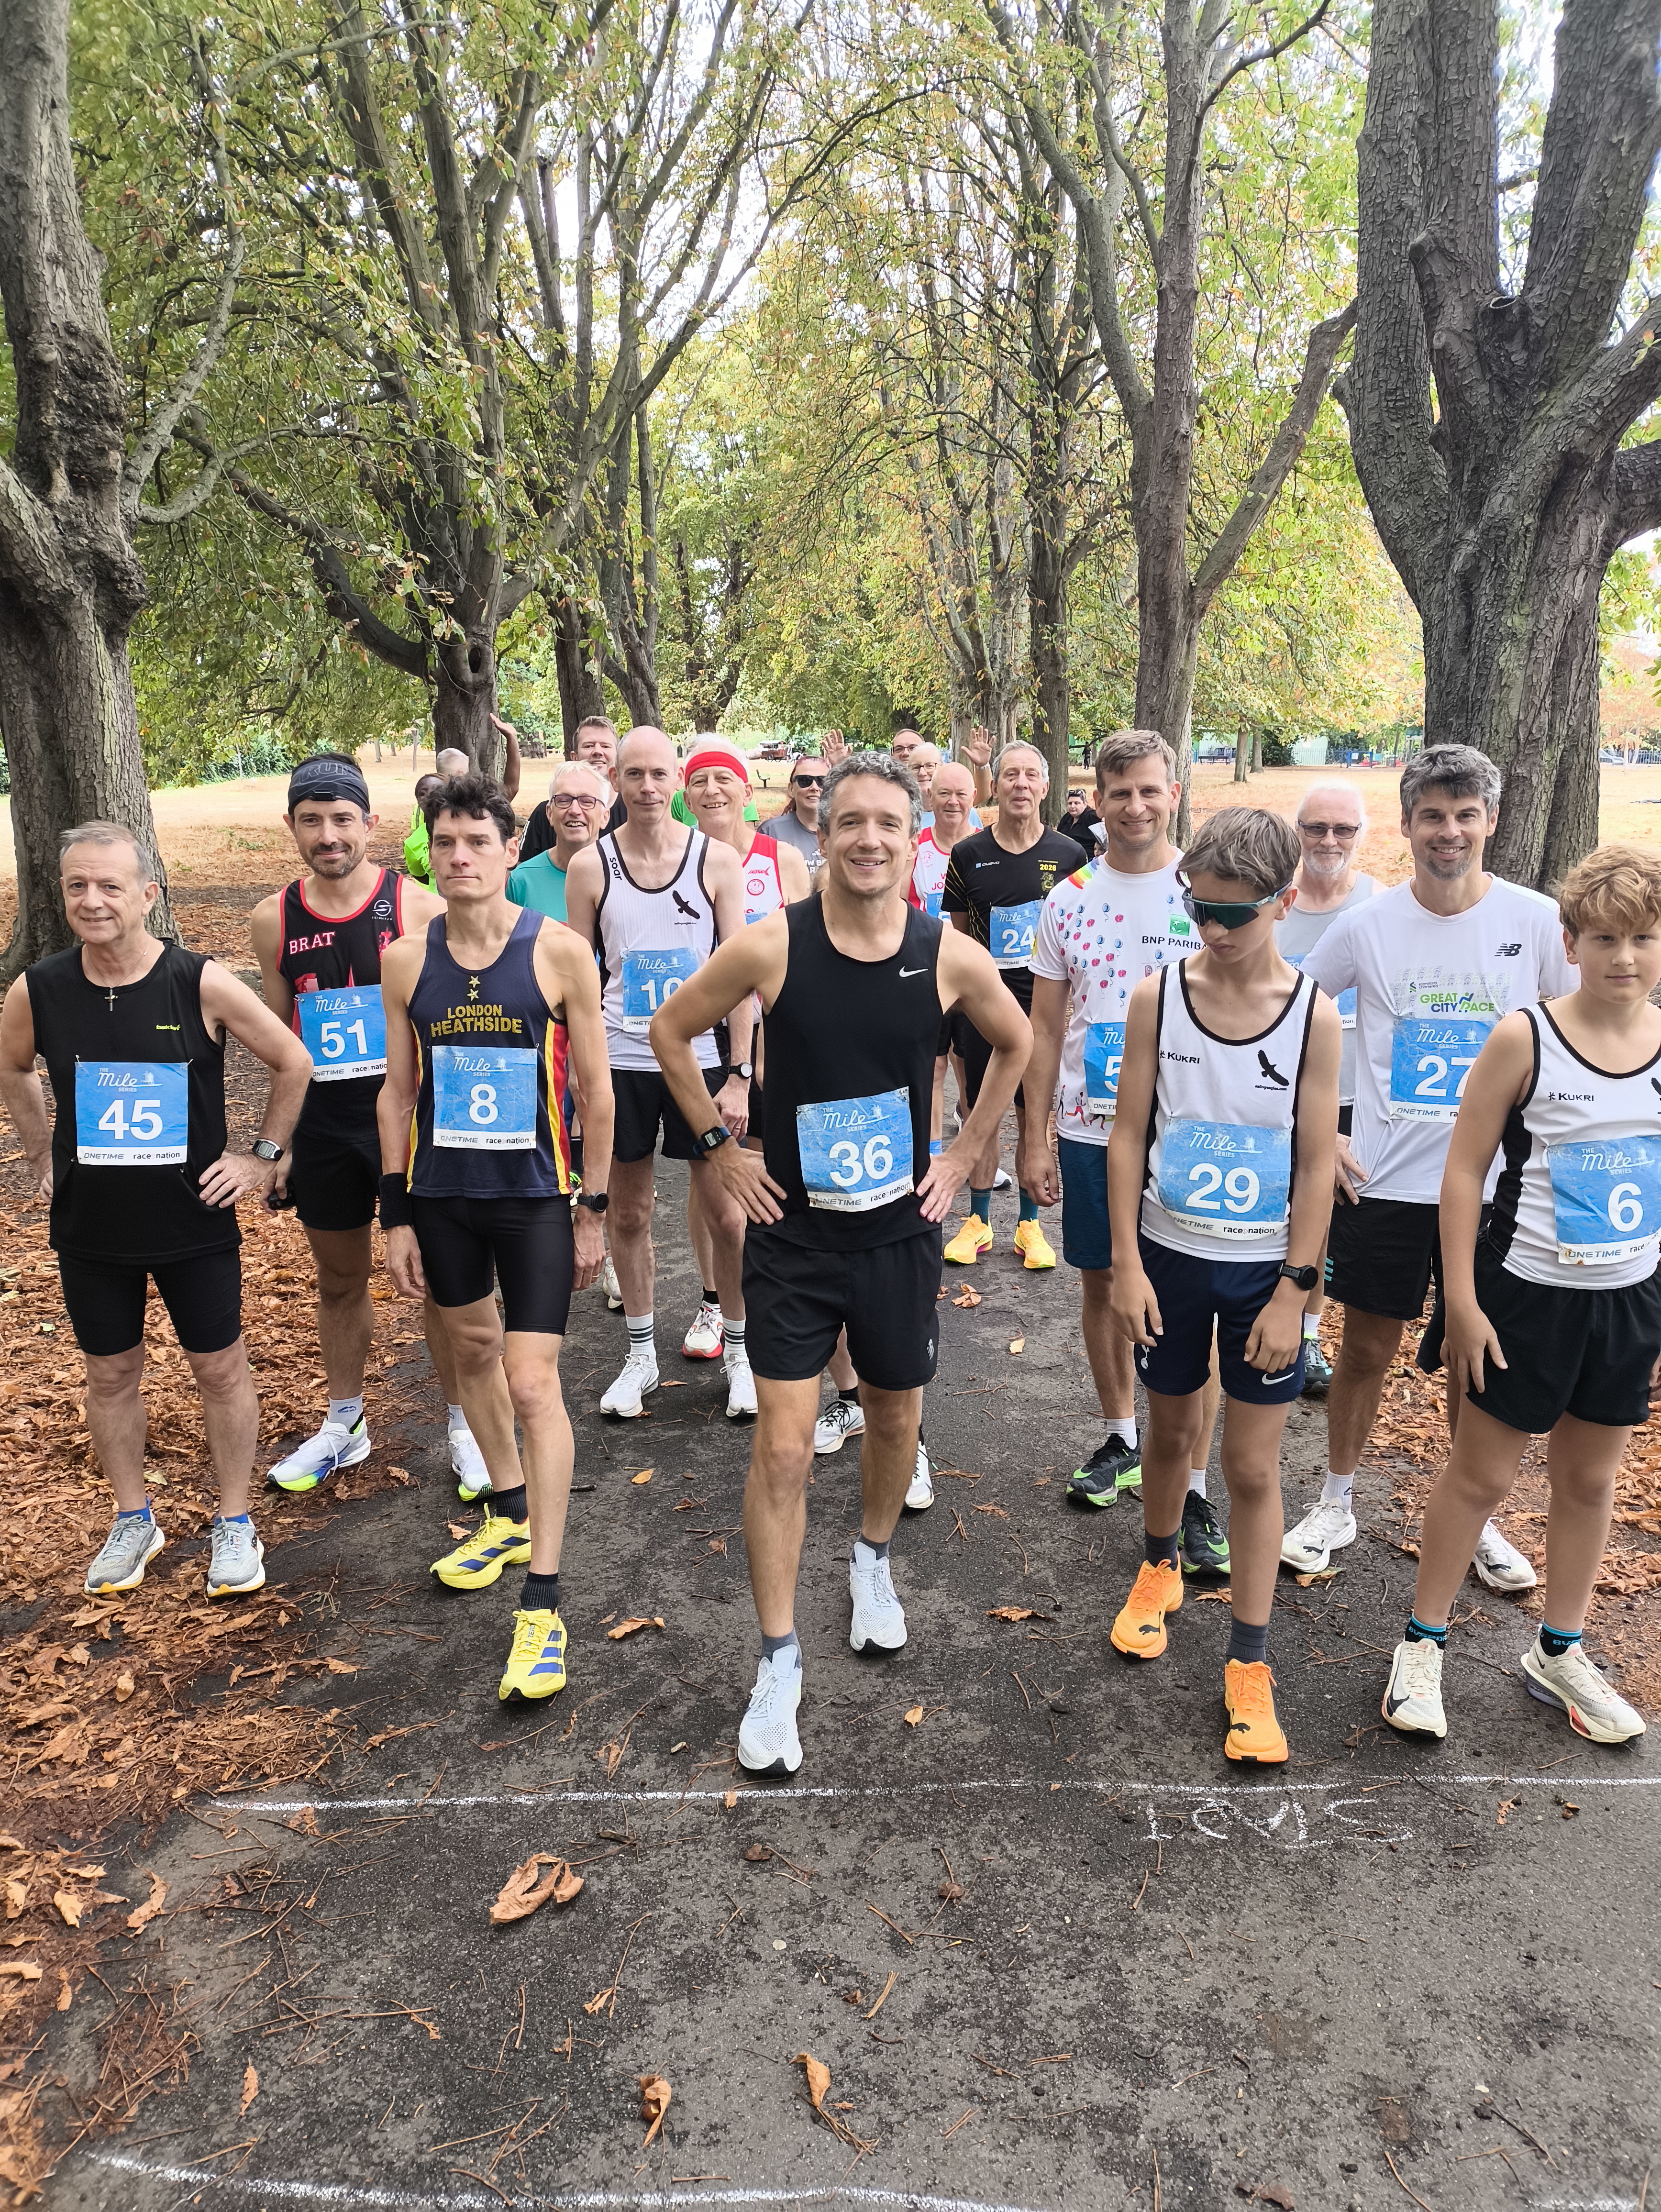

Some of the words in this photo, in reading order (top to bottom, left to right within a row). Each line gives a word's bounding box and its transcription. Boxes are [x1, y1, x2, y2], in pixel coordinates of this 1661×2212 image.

[609, 857, 622, 881] soar
[999, 912, 1033, 922] Mile
[288, 931, 336, 955] BRAT
[1002, 924, 1035, 953] 24
[1142, 936, 1165, 944] BNP
[1168, 938, 1207, 951] PARIBA
[637, 958, 684, 970] Mile
[315, 997, 368, 1013] Mile
[1420, 993, 1458, 1004] GREAT
[447, 1004, 503, 1019] LONDON
[1431, 1002, 1458, 1013] CITY
[430, 1017, 522, 1037] HEATHSIDE
[321, 1018, 368, 1059] 51
[1103, 1031, 1126, 1045] Mi
[1416, 1028, 1483, 1044] Mile
[454, 1056, 514, 1072] Mile
[1167, 1052, 1200, 1064] KUKRI
[312, 1069, 344, 1077] ONETIME
[371, 1062, 388, 1071] natio
[1104, 1055, 1123, 1093] 5
[1414, 1054, 1478, 1097] 27
[97, 1072, 163, 1087] Mile
[469, 1083, 498, 1125] 8
[1558, 1093, 1594, 1101] KUKRI
[98, 1099, 163, 1140] 45
[823, 1110, 891, 1129] Mile
[1396, 1107, 1441, 1116] ONETIME
[1189, 1131, 1263, 1153] Mile
[829, 1134, 893, 1187] 36
[1582, 1151, 1655, 1172] Mile
[1185, 1162, 1260, 1214] 29
[871, 1193, 886, 1202] race
[1607, 1182, 1644, 1233] 6
[1173, 1217, 1214, 1230] NETIME
[1629, 1244, 1645, 1253] race
